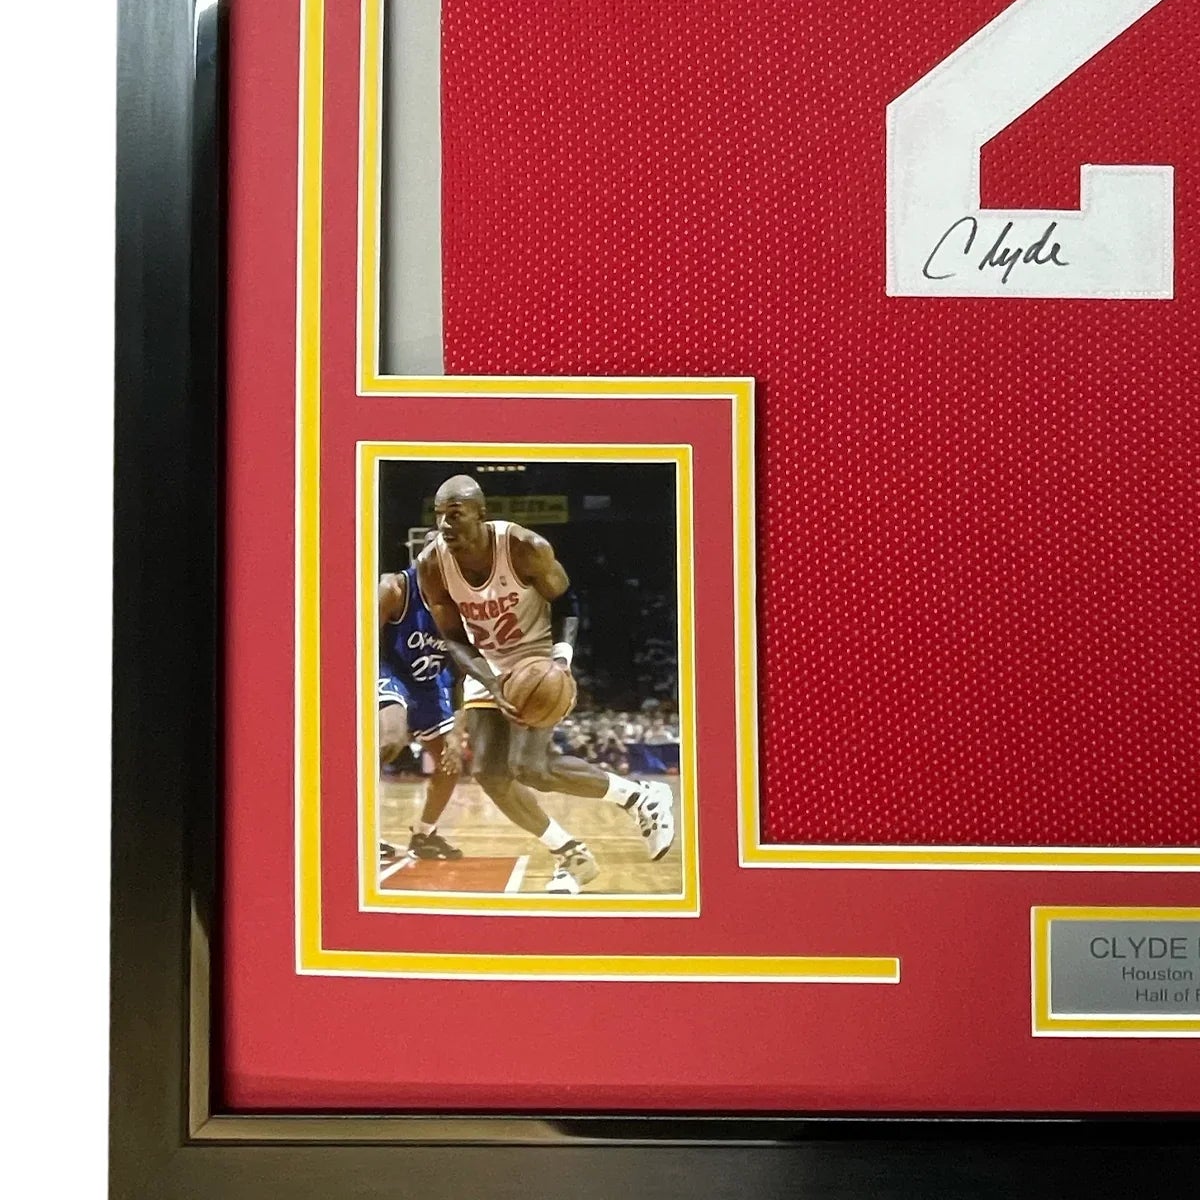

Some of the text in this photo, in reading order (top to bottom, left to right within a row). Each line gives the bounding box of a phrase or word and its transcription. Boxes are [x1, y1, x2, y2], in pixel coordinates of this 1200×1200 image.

[922, 216, 1070, 285] Clyde
[467, 612, 524, 650] 22
[411, 654, 445, 681] 25
[1089, 936, 1188, 960] CLYDE
[1121, 966, 1193, 982] Houston
[1135, 988, 1168, 1003] Hall
[1173, 988, 1190, 1003] of
